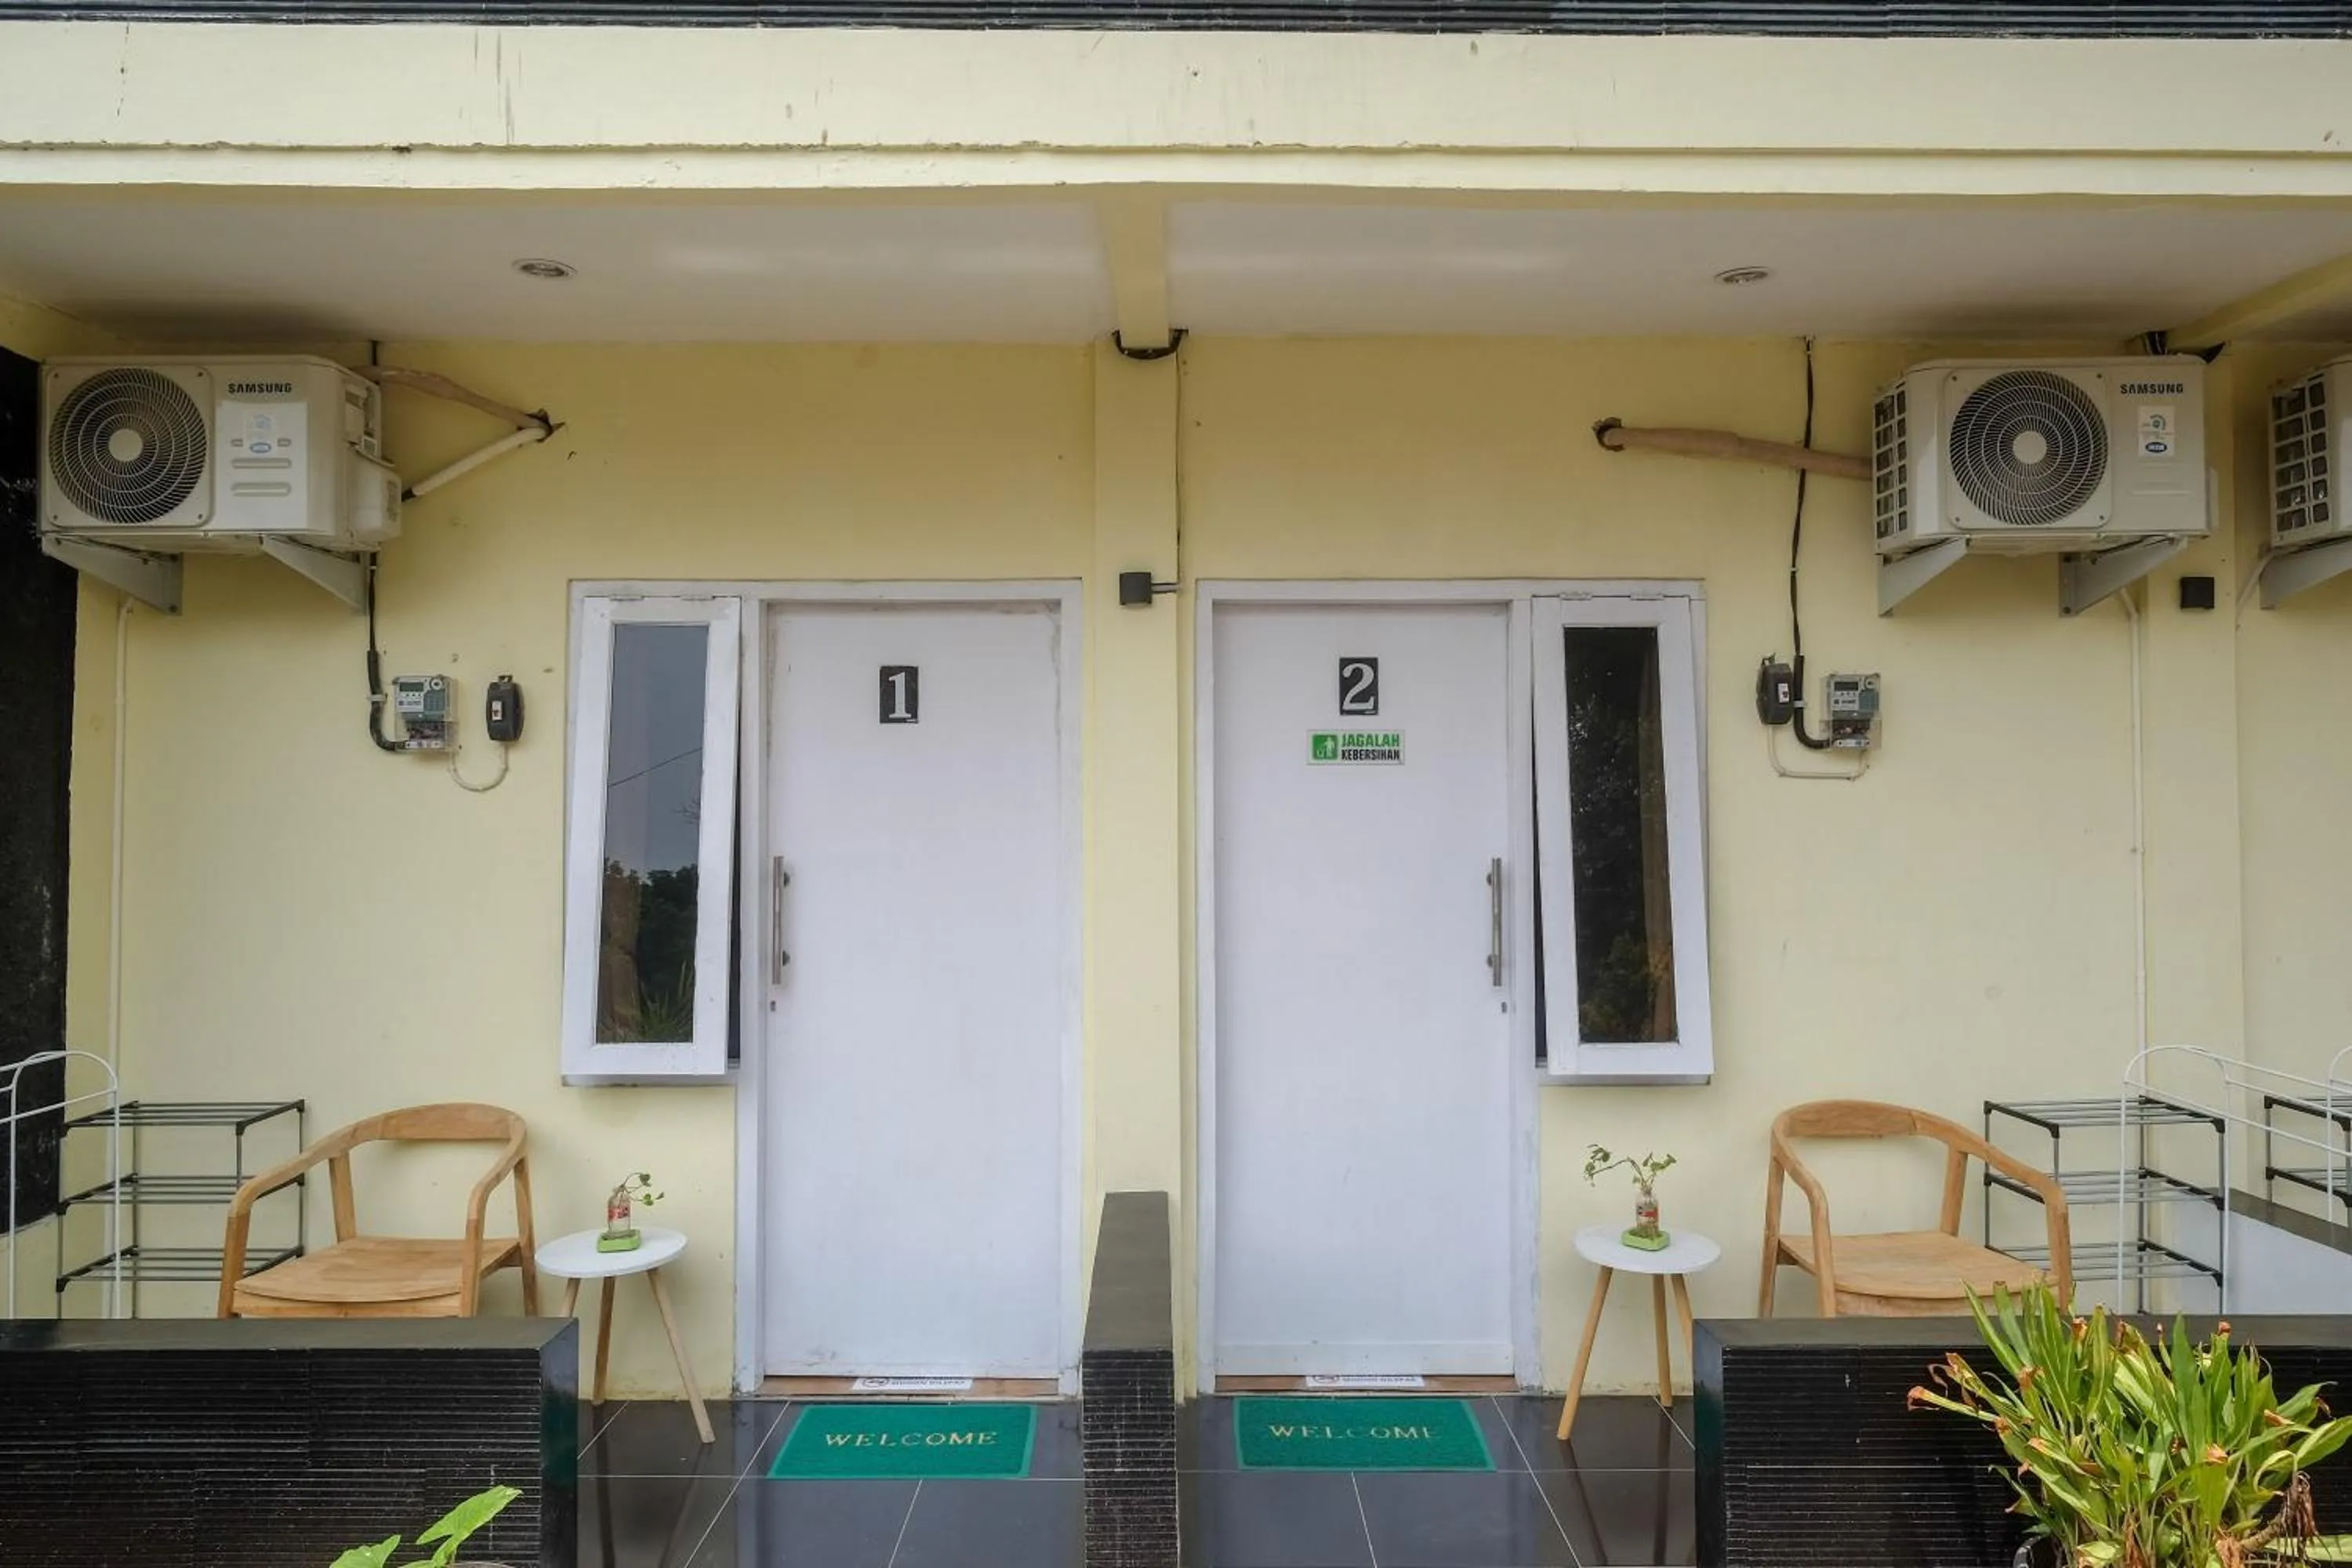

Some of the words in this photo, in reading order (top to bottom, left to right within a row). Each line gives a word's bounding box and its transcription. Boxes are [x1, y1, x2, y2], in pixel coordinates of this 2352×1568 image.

[227, 383, 292, 394] SAMSUNG
[2120, 383, 2183, 394] SAMSUNG
[1342, 662, 1375, 710] 2
[888, 671, 912, 718] 1
[1341, 734, 1399, 747] JAGALAH
[1341, 749, 1400, 760] KEBERSIHAN
[1269, 1425, 1441, 1439] WELCOME
[826, 1432, 997, 1446] WELCOME
